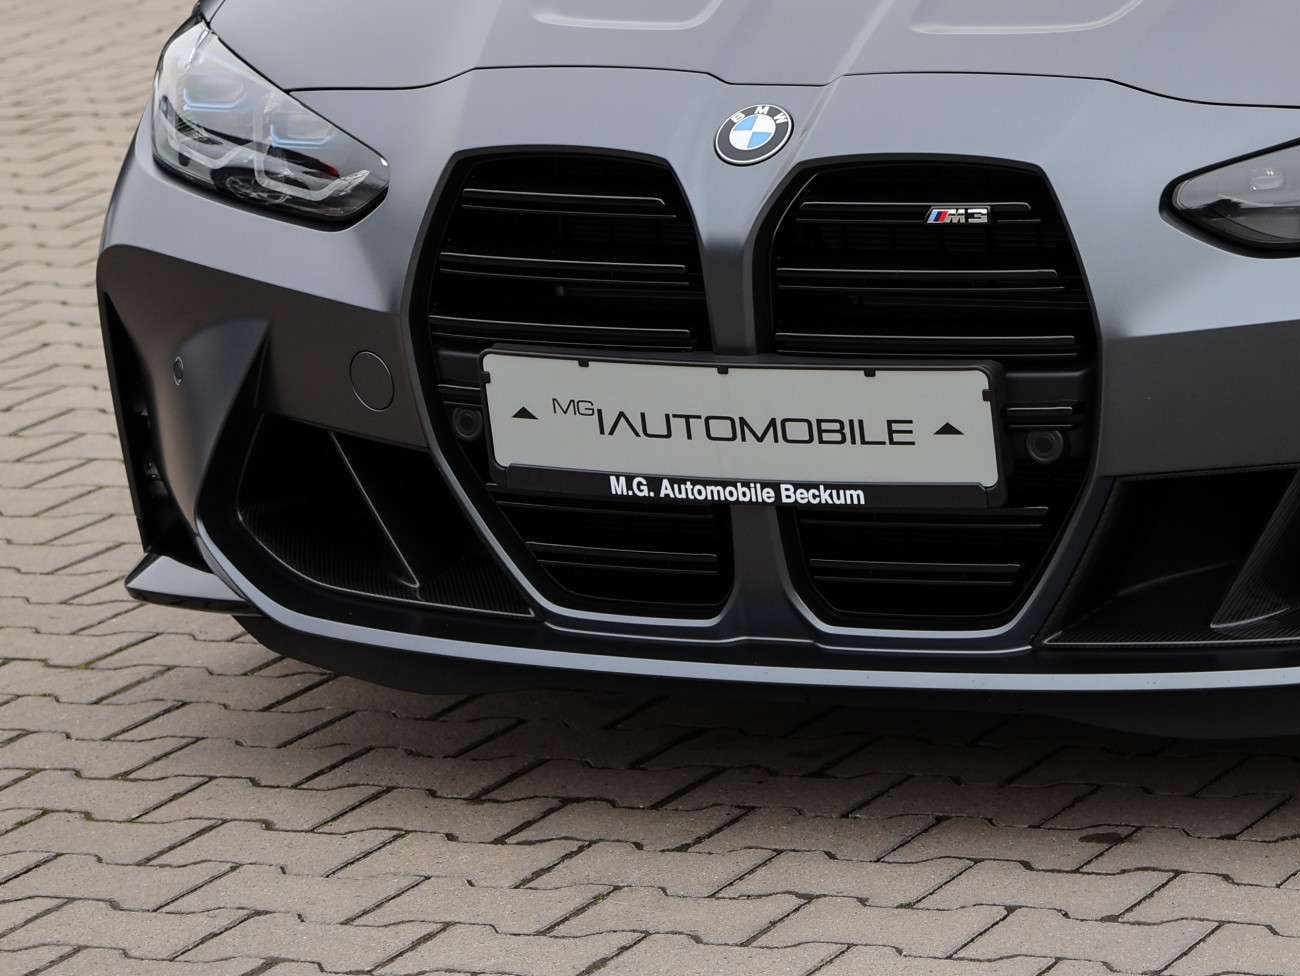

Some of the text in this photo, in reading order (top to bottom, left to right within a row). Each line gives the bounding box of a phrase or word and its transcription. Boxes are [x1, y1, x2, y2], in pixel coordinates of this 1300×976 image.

[730, 105, 788, 124] BMW
[943, 208, 988, 224] M3
[551, 398, 594, 416] MG
[609, 475, 866, 506] M.G. Automobile Beckum
